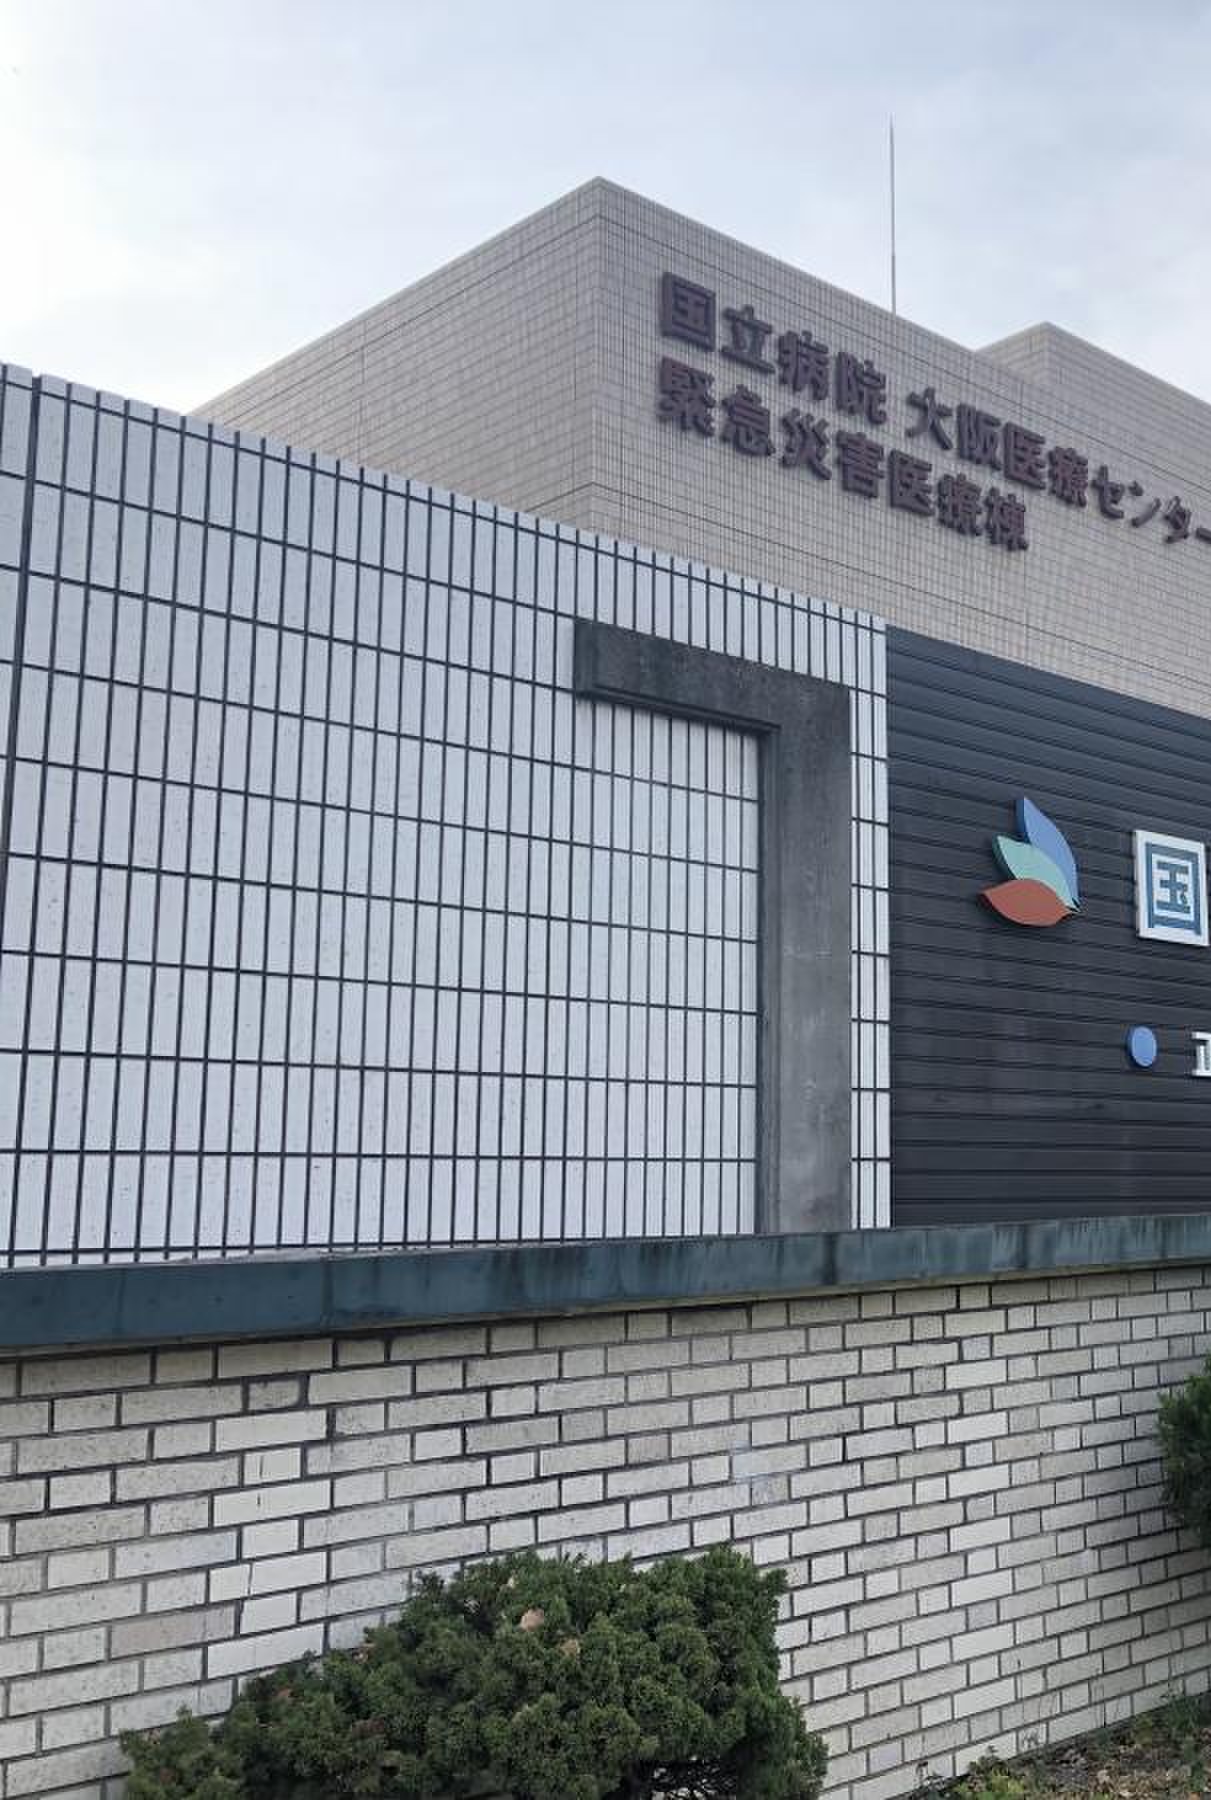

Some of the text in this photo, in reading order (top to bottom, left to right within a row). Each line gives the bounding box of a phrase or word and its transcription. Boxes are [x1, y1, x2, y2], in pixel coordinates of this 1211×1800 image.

[659, 271, 888, 426] 国立病院
[656, 355, 1029, 552] 緊急災害医療棟
